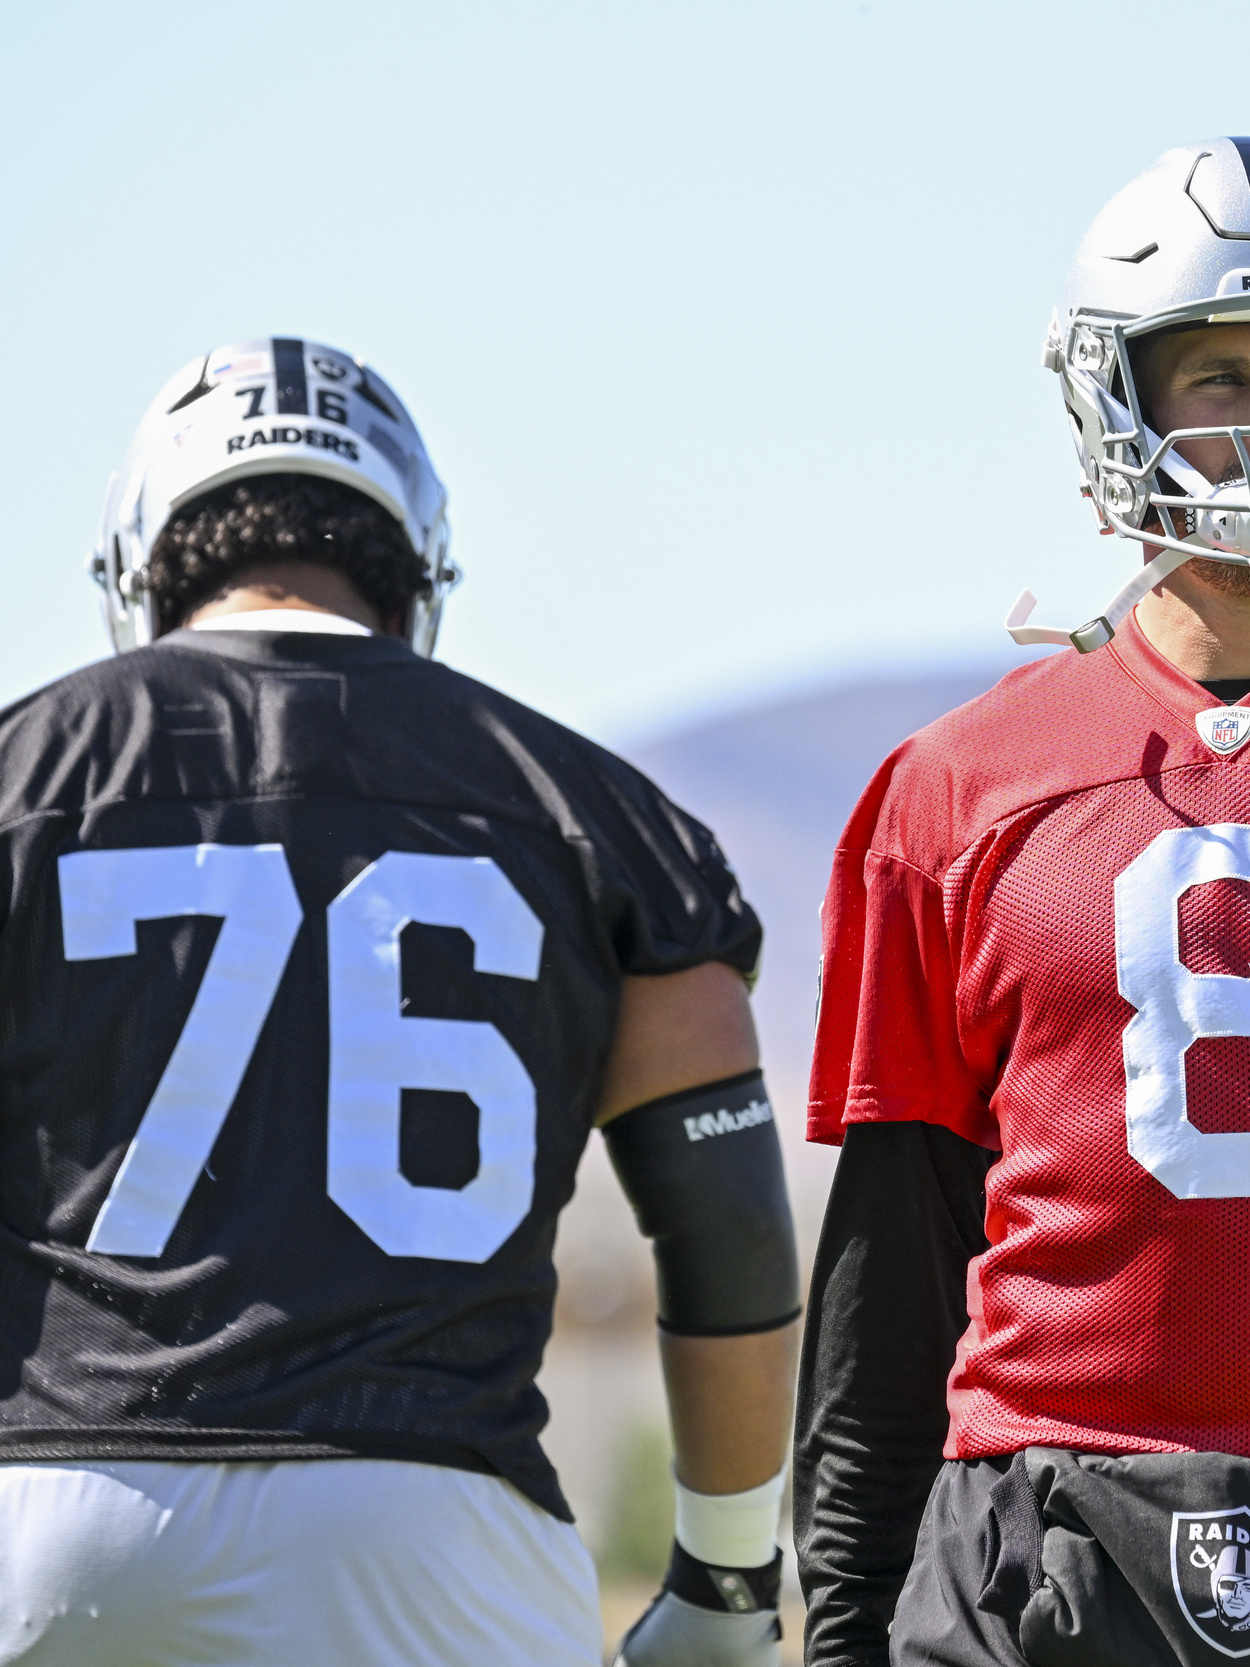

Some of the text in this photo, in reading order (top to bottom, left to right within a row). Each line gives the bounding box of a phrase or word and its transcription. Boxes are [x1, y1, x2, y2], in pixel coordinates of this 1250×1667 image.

[226, 426, 360, 463] RAIDERS
[1214, 729, 1236, 742] NFL
[58, 843, 544, 1263] 76
